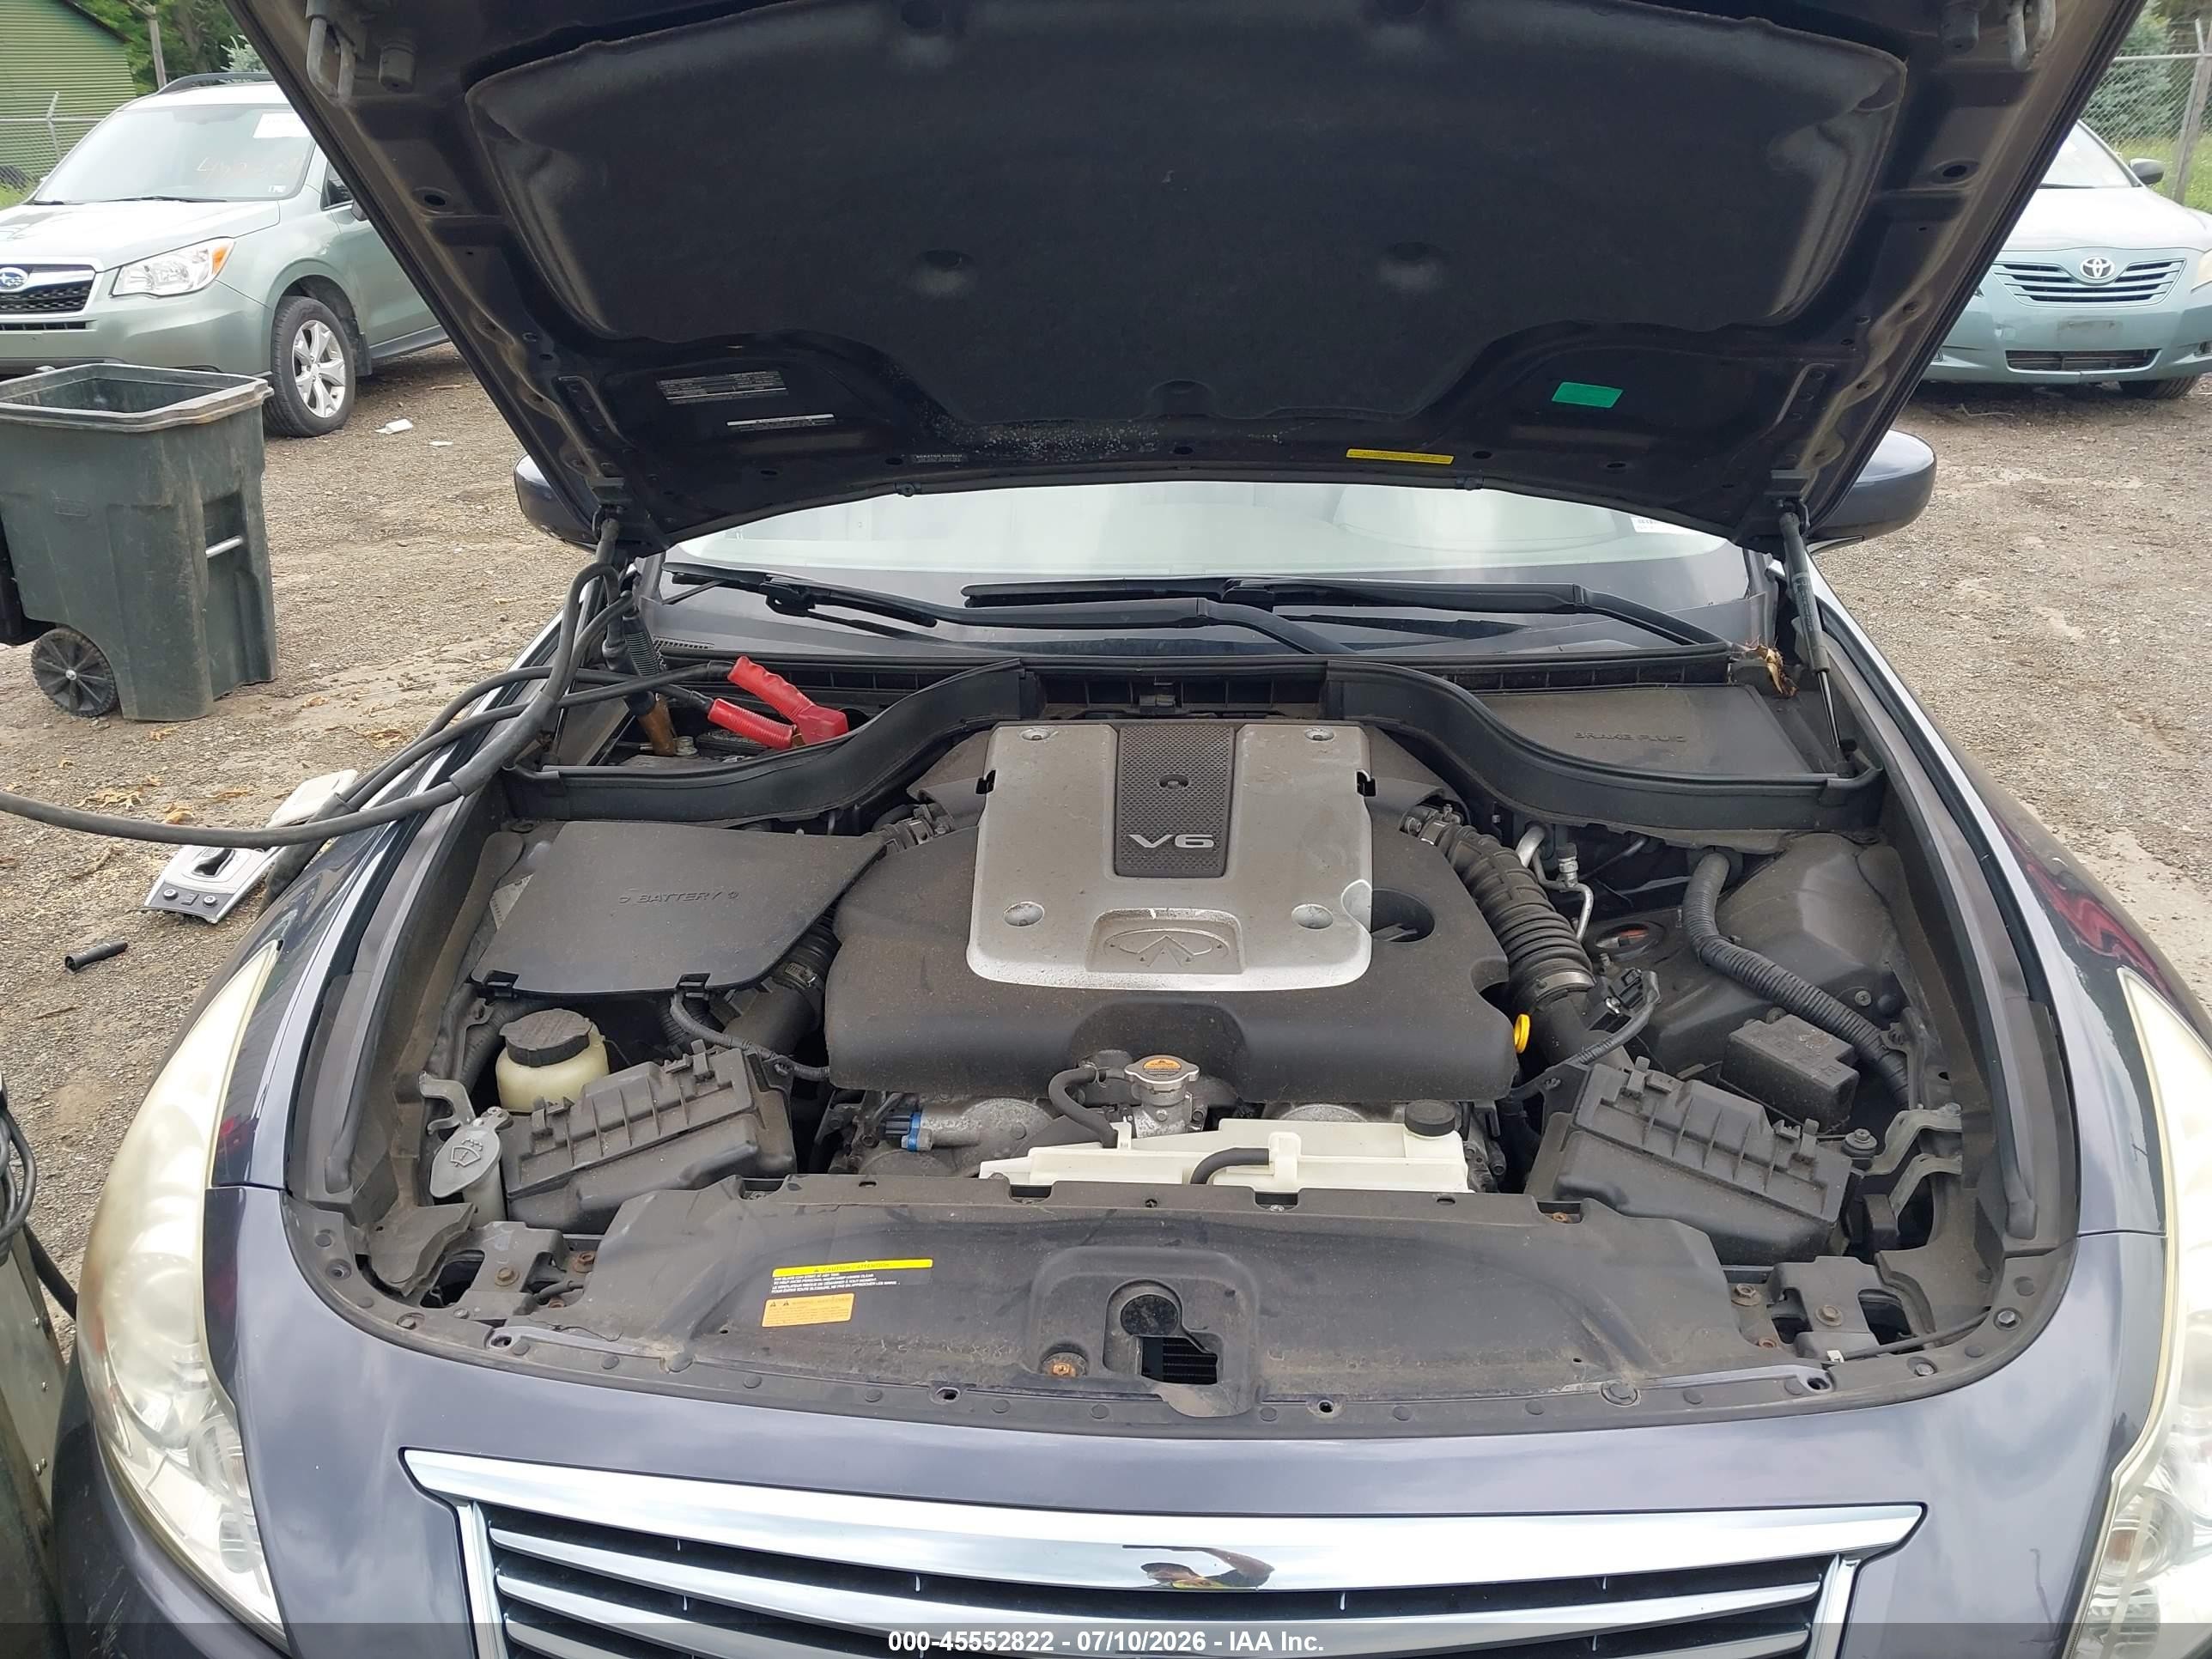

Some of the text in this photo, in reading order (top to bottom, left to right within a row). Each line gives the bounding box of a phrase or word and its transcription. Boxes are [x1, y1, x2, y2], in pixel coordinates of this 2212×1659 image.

[1573, 731, 1686, 743] BRAKE FLUID
[1127, 833, 1215, 848] V6
[636, 890, 722, 904] BATTERY
